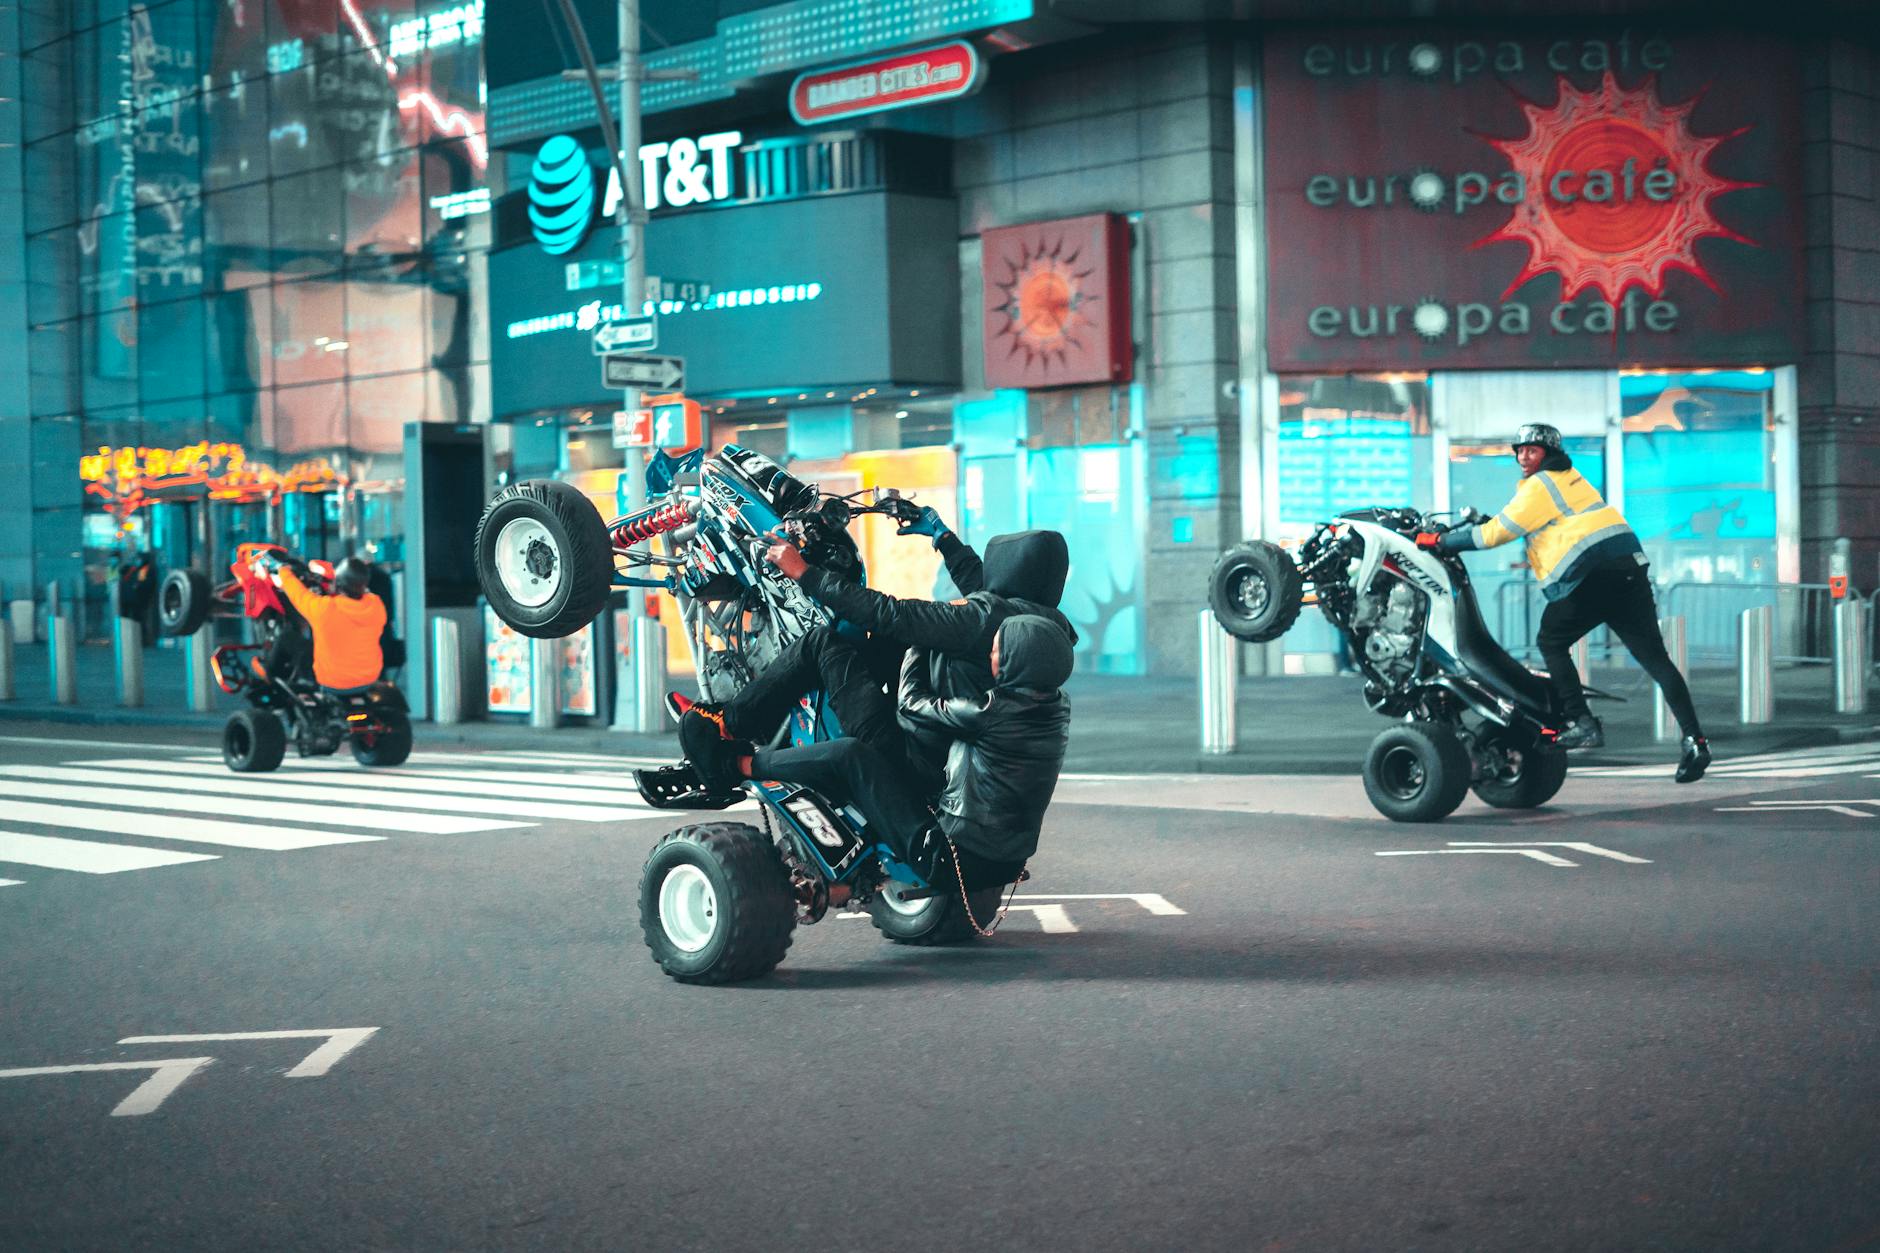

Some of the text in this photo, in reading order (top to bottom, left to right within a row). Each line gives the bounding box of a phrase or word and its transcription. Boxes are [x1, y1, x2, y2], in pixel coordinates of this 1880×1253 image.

[602, 131, 742, 217] AT&T
[1306, 170, 1527, 214] europa
[1307, 300, 1530, 346] europa
[706, 476, 755, 511] TRX
